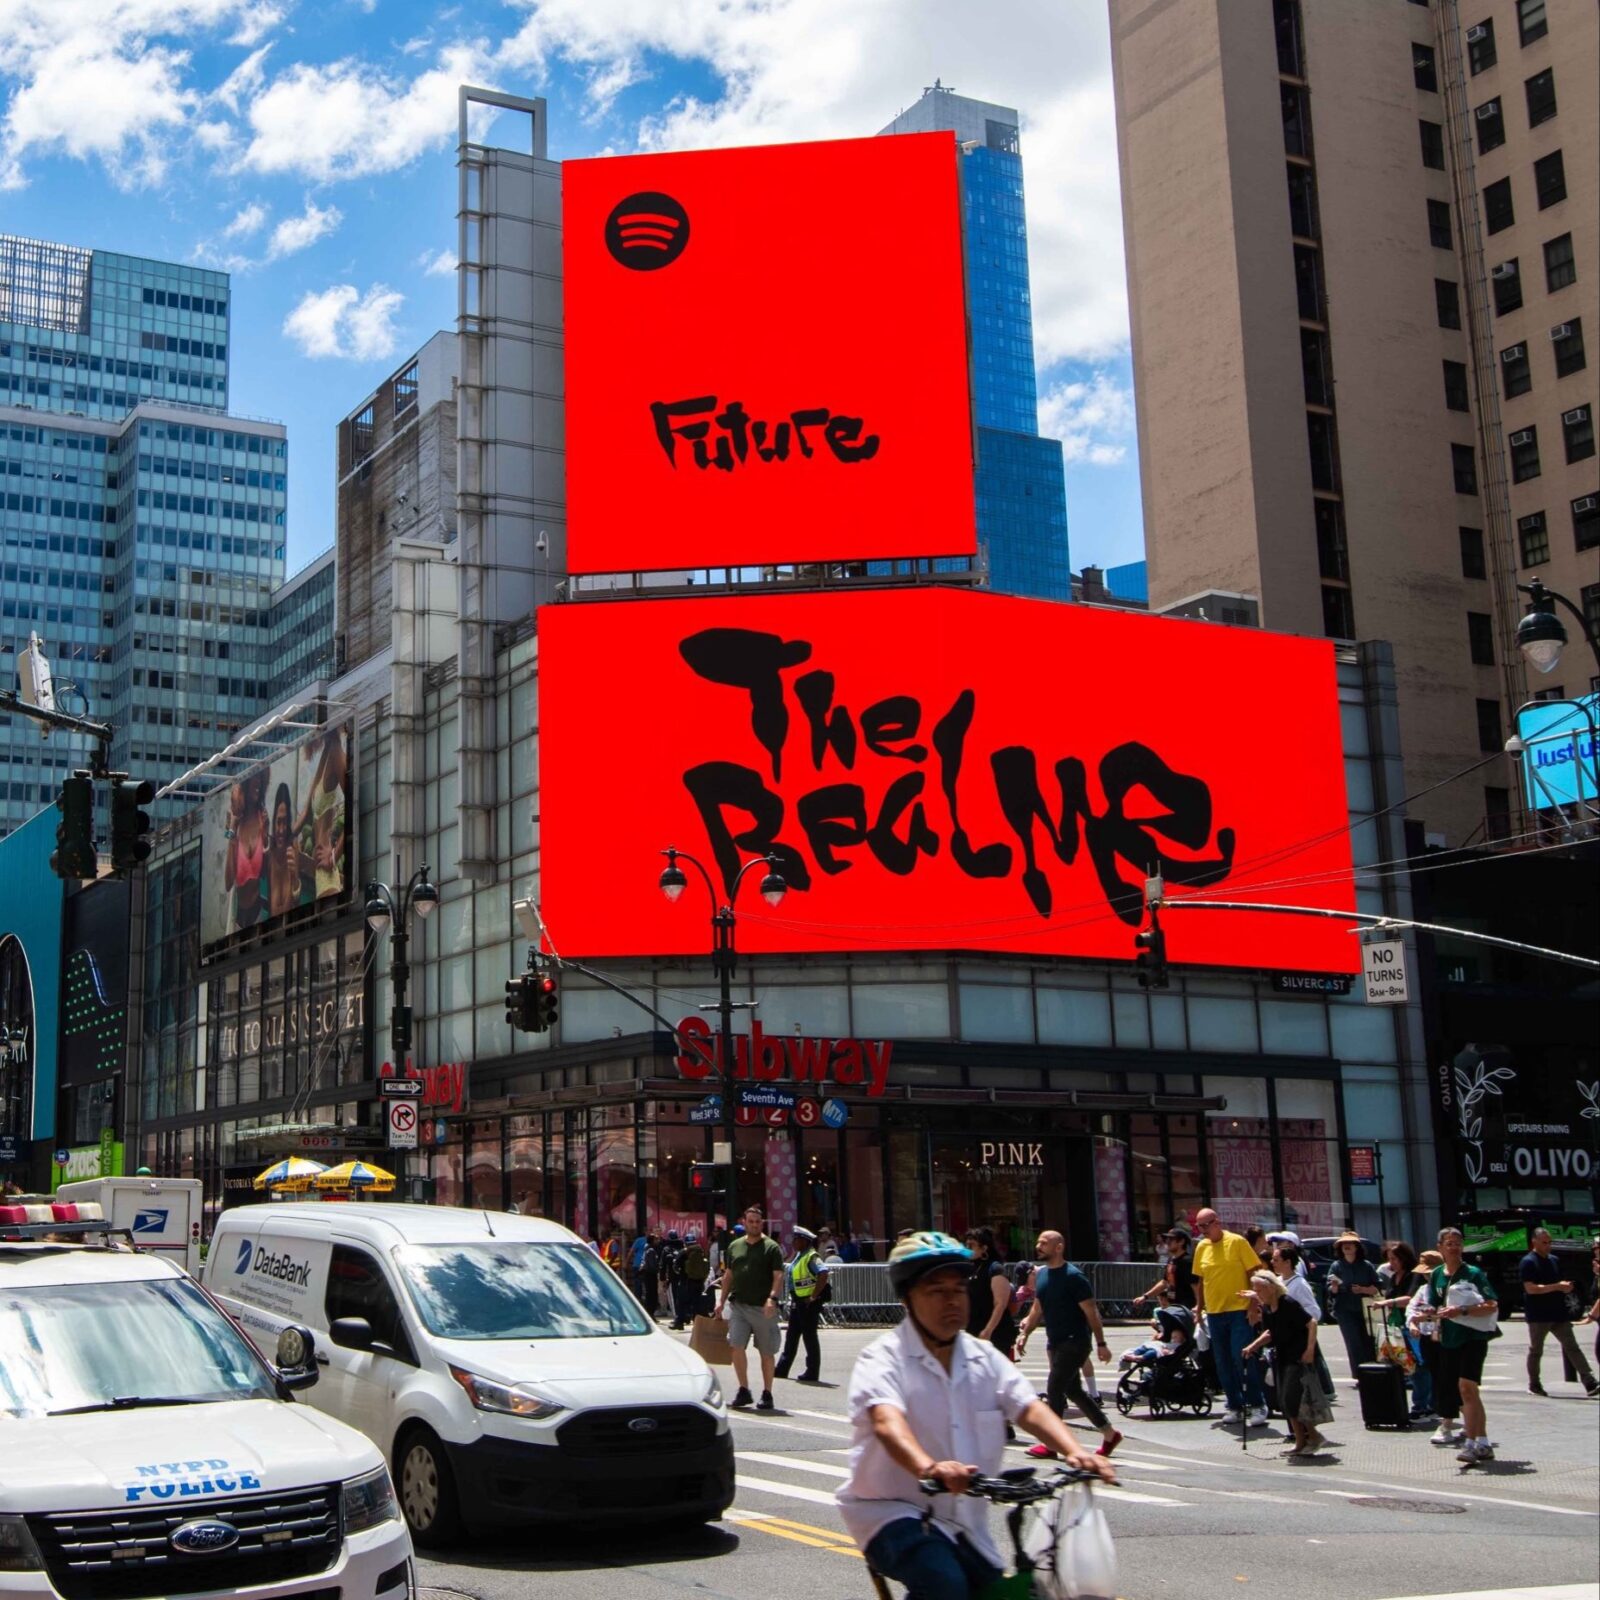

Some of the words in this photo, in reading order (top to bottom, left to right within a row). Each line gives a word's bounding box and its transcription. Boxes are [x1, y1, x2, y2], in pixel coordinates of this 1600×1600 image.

[650, 395, 880, 472] Future
[679, 628, 928, 783] The
[1537, 742, 1574, 769] Just
[1373, 949, 1394, 964] NO
[1367, 968, 1404, 982] TURNS
[1369, 986, 1405, 998] 8AM-8PM
[674, 1016, 894, 1097] Subway
[1439, 1065, 1452, 1107] OLIYO
[742, 1092, 776, 1104] Seventh
[777, 1096, 794, 1106] Ave
[691, 1111, 703, 1120] West
[713, 1108, 720, 1118] St
[770, 1109, 782, 1121] 2
[801, 1102, 814, 1122] 3
[823, 1100, 842, 1122] MTA
[1508, 1123, 1542, 1133] UPSTAIRS
[1543, 1124, 1570, 1134] DINING
[103, 1132, 112, 1174] crocs
[980, 1142, 1044, 1165] PINK
[1514, 1147, 1591, 1177] OLIYO
[1490, 1162, 1508, 1173] DELI
[253, 1246, 312, 1287] DataBank
[135, 1458, 229, 1477] NYPD
[125, 1470, 261, 1502] POLICE
[188, 1528, 226, 1547] Ford
